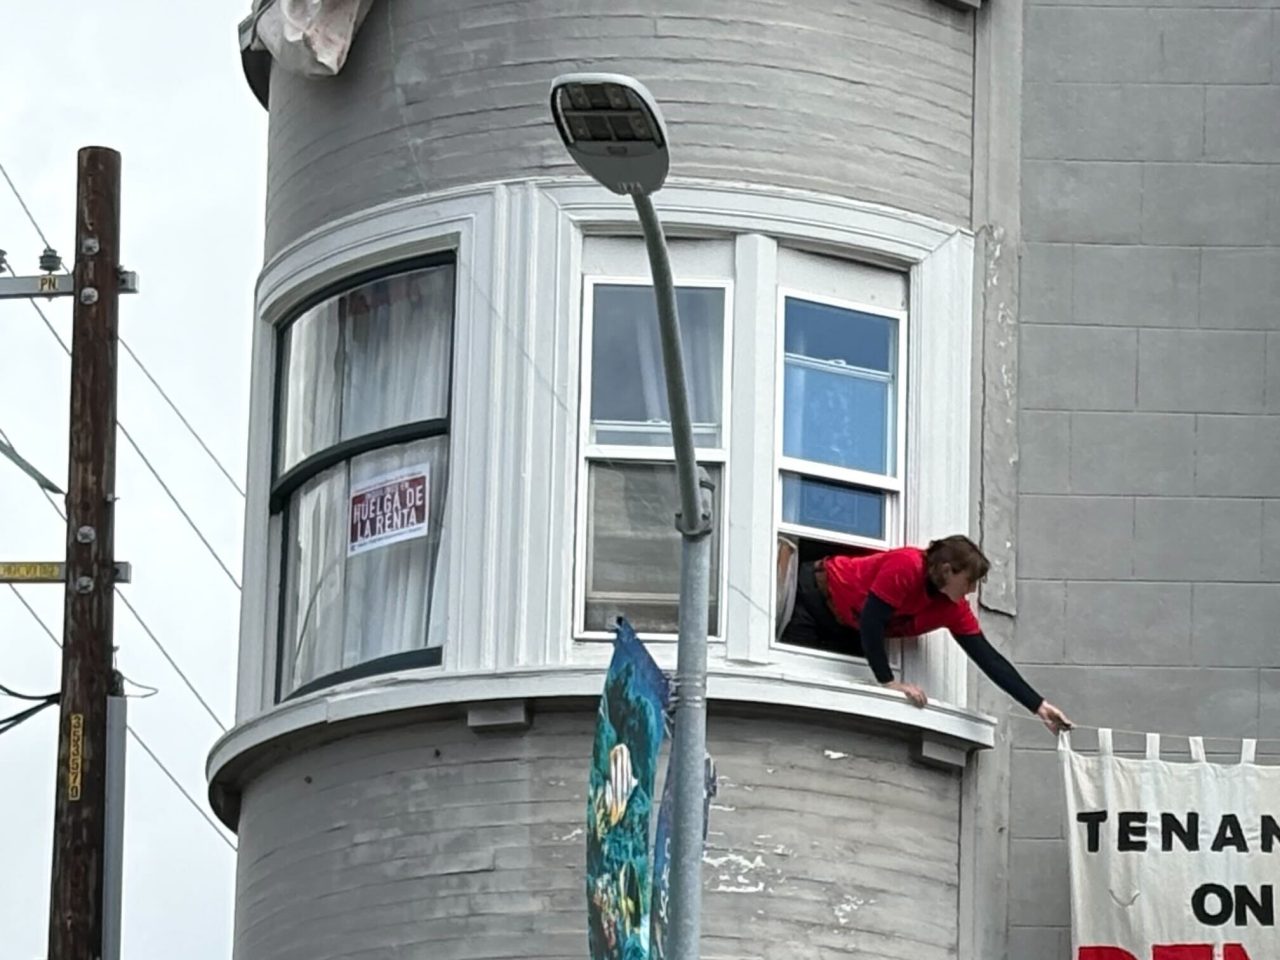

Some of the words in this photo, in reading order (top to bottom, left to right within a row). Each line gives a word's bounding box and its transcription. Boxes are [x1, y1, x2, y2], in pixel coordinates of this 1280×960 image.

[353, 490, 401, 525] HUELGA
[406, 484, 424, 508] DE
[358, 518, 372, 542] LA
[376, 506, 418, 536] RENTA
[1191, 883, 1275, 926] ON
